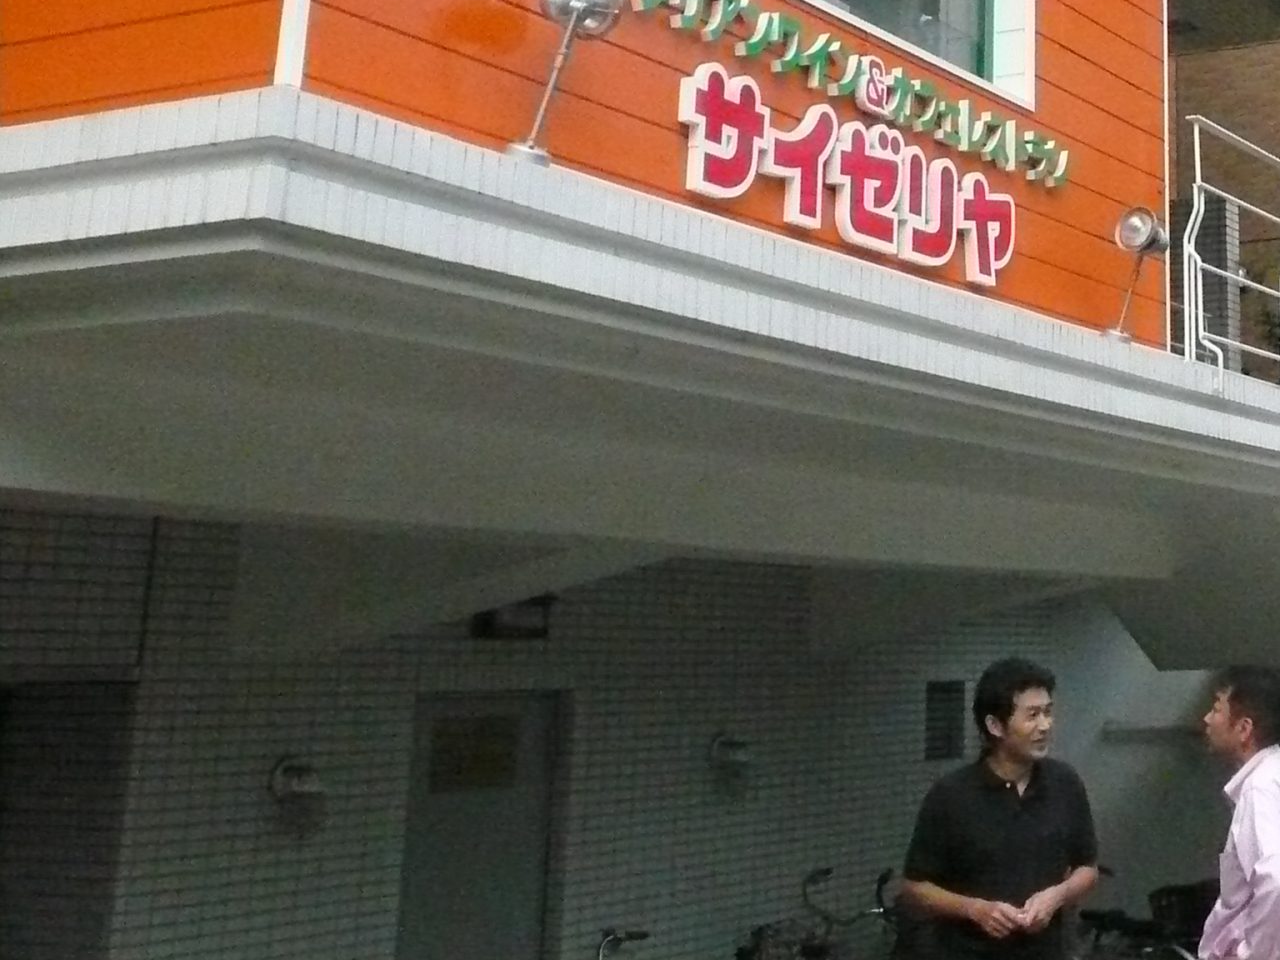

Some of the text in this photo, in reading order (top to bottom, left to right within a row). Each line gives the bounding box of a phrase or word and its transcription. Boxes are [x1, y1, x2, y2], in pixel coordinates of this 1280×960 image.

[678, 62, 1016, 286] サイゼリヤ
